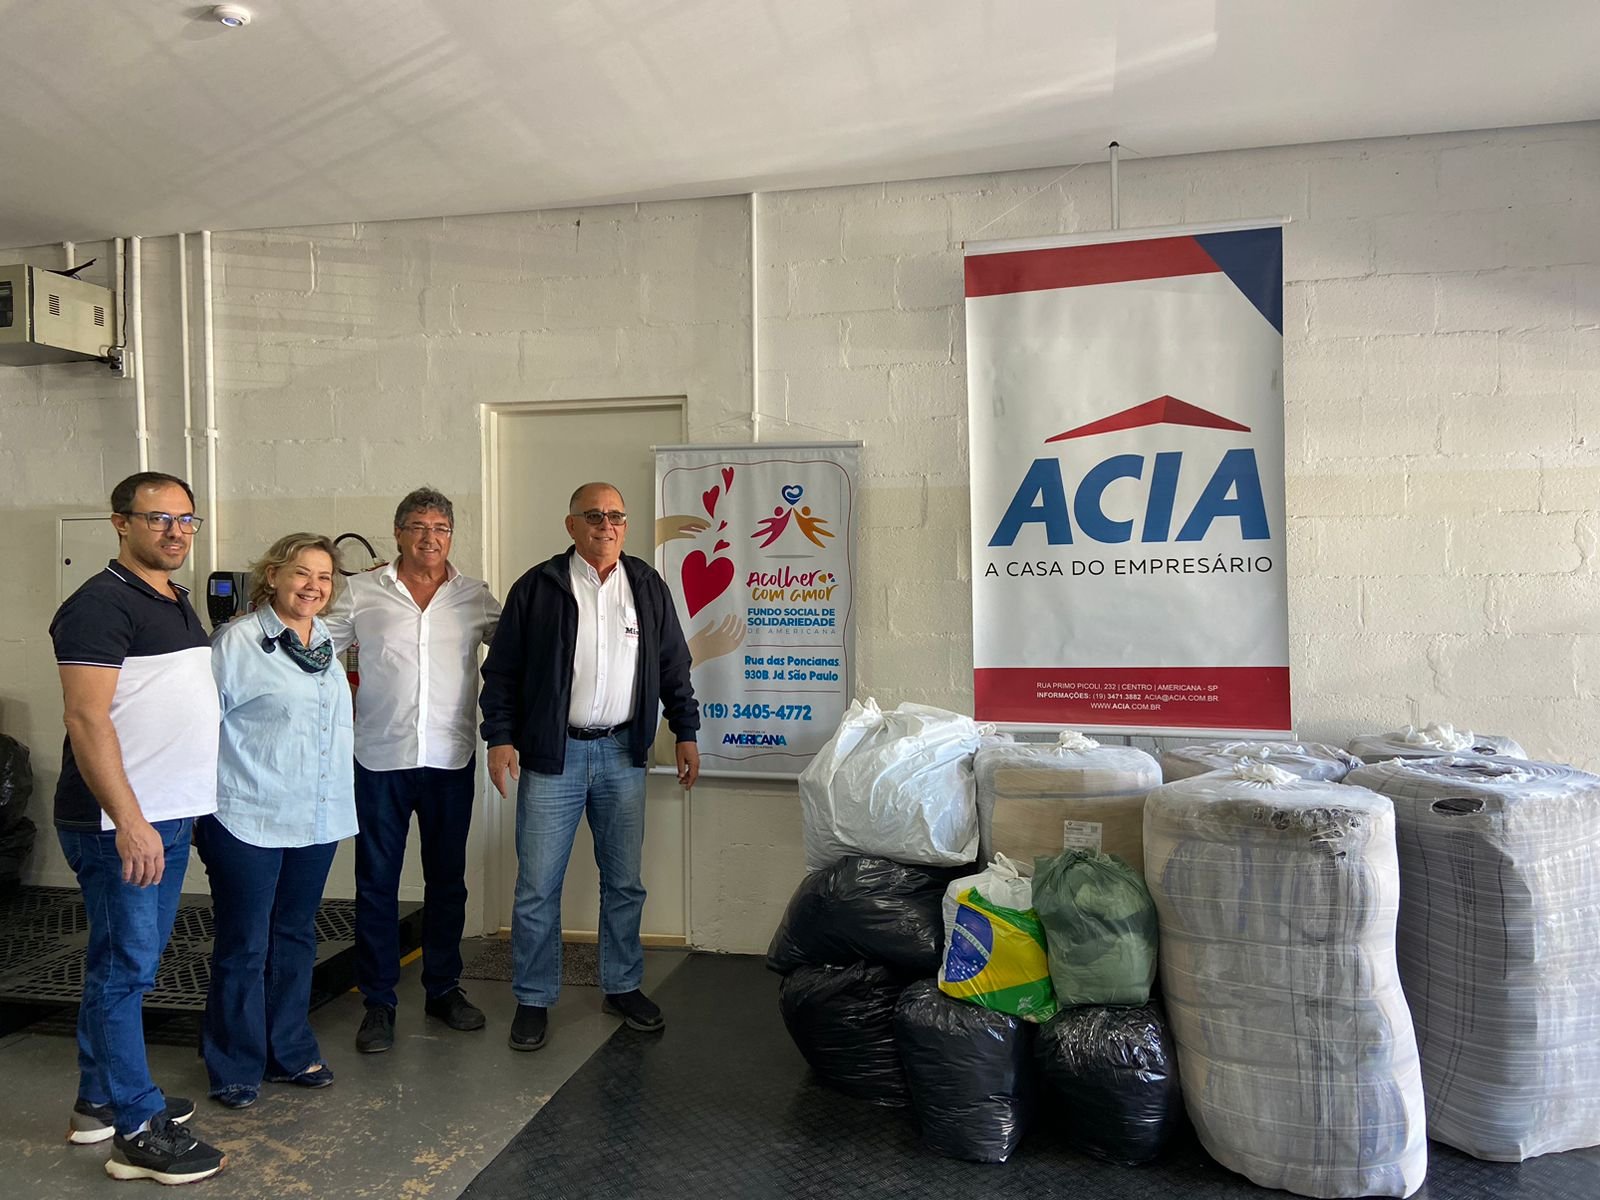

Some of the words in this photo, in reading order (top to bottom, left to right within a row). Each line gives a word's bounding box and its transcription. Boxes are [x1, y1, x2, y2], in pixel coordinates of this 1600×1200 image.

[987, 448, 1271, 547] ACIA
[985, 562, 999, 577] A
[1006, 561, 1064, 577] CASA
[1072, 560, 1105, 576] DO
[1114, 553, 1273, 575] EMPRESÁRIO
[746, 566, 822, 588] Acolher
[752, 587, 785, 602] com
[790, 584, 839, 602] amor
[747, 608, 782, 616] FUNDO
[784, 608, 819, 616] SOCIAL
[821, 608, 835, 616] DE
[747, 617, 836, 627] SOLIDARIEDADE
[744, 655, 764, 665] Rua
[766, 655, 785, 665] das
[788, 669, 807, 681] São
[809, 670, 839, 681] Paulo
[703, 703, 729, 719] (19)
[732, 703, 812, 720] 3405-4772
[1090, 702, 1161, 711] WWW.ACIA.COM.BR
[722, 733, 787, 746] AMERICANA
